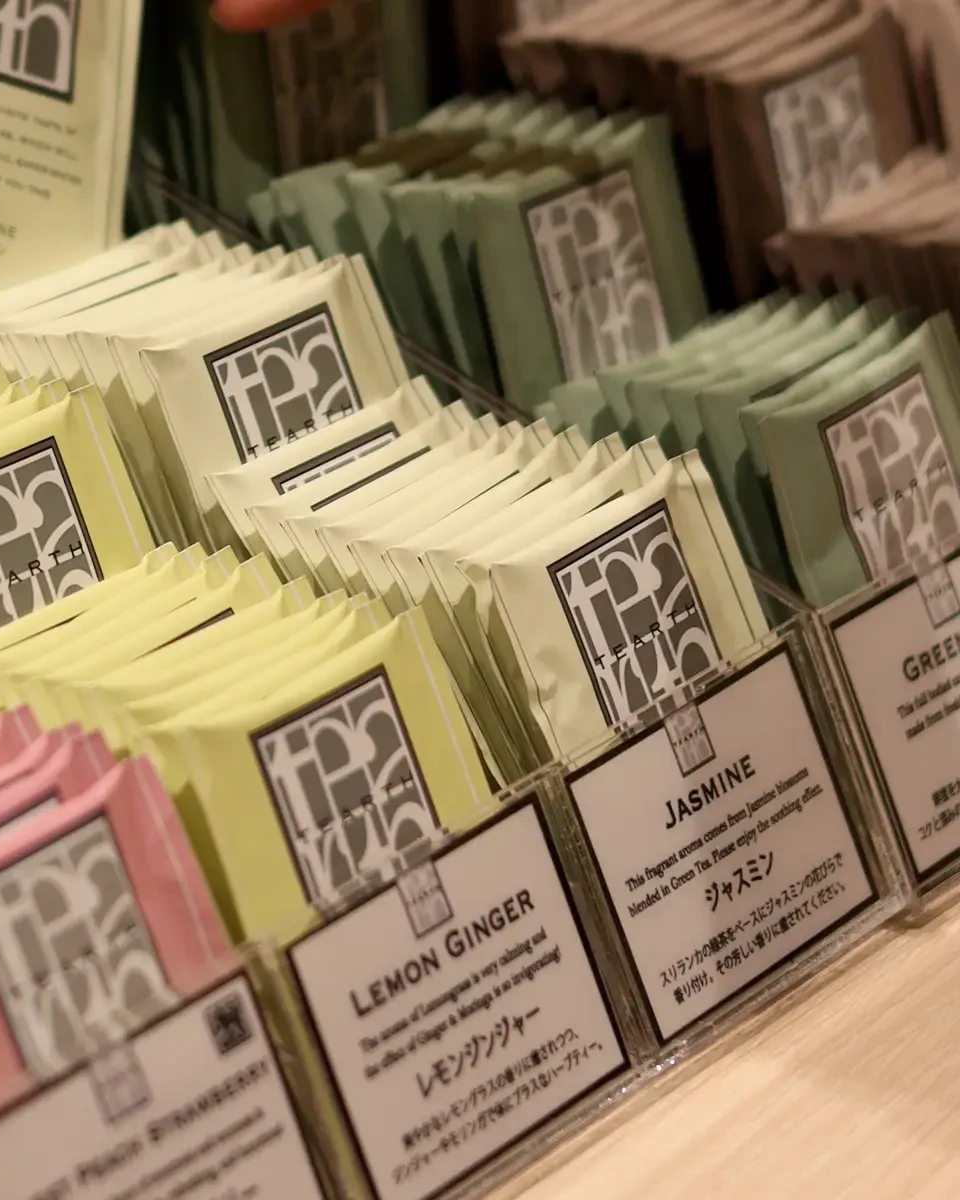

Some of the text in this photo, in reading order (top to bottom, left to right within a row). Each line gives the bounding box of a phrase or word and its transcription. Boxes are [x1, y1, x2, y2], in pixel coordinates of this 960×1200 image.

[247, 402, 355, 459] TEARTH
[595, 601, 696, 669] TEARTH
[665, 754, 756, 829] JASMINE
[624, 767, 810, 893] This fragrant aroma comes from Jasmine blossoms
[627, 783, 824, 918] blended in Green Tea. Please enjoy the soothing effect.
[705, 851, 774, 912] ジャスミン
[350, 889, 534, 1018] LEMON GINGER
[470, 972, 482, 985] is
[479, 960, 499, 979] very
[498, 939, 534, 967] calming
[531, 926, 548, 947] and
[492, 985, 503, 999] is
[500, 979, 512, 993] so
[511, 945, 561, 986] invigorating!
[416, 1007, 540, 1098] レモンジンジャー
